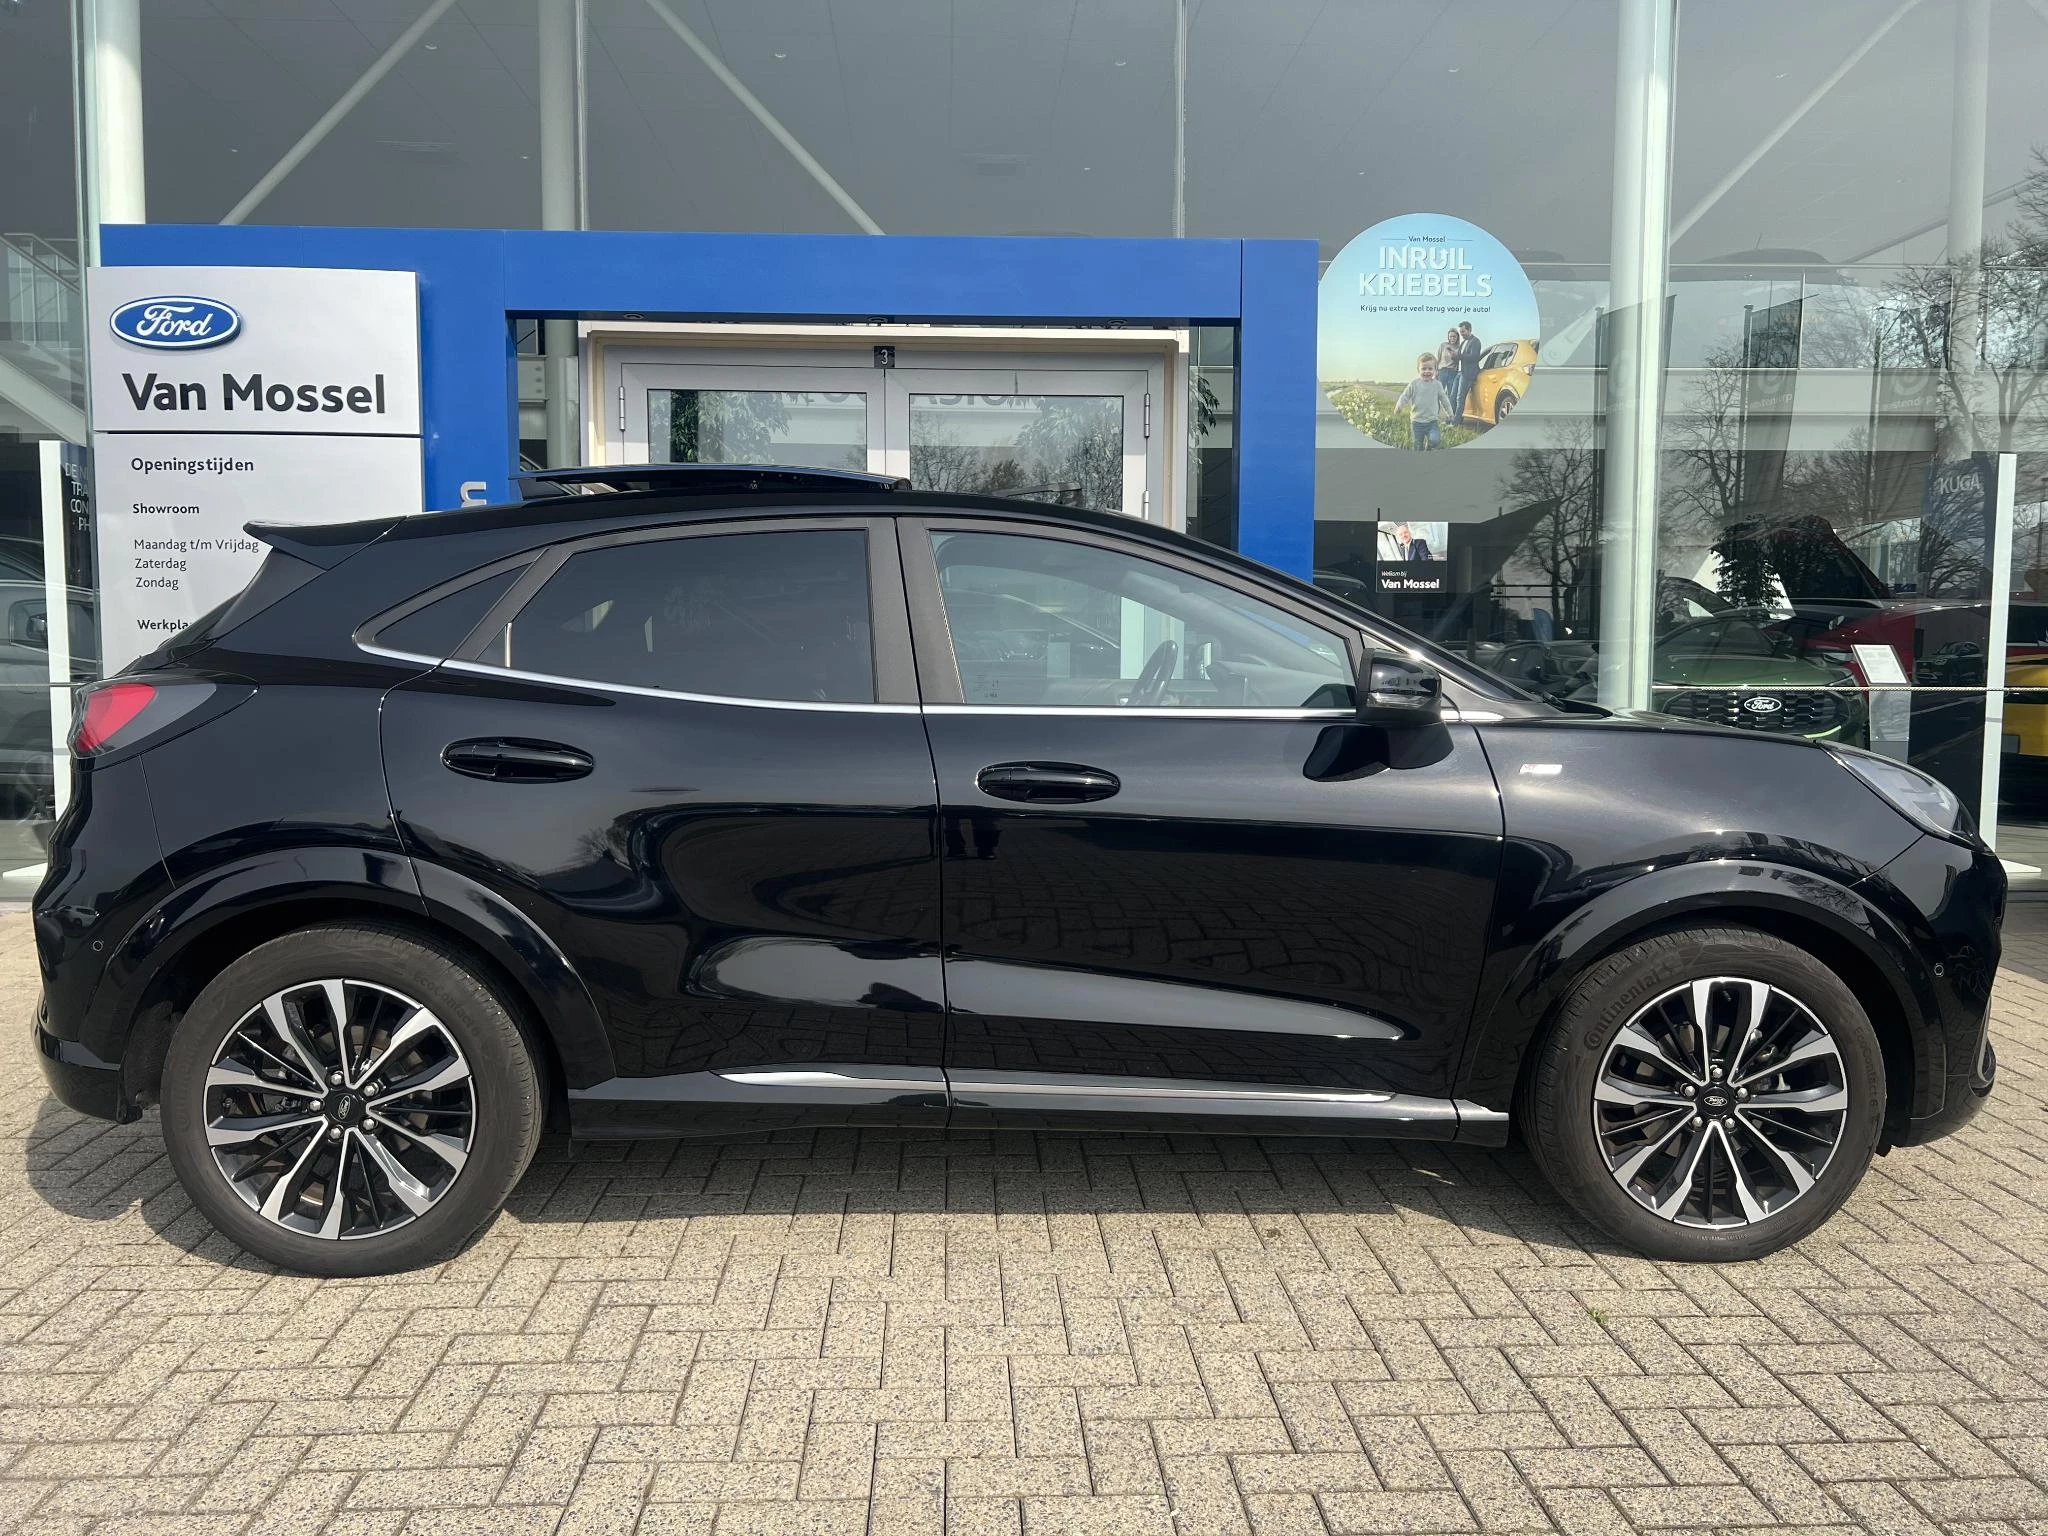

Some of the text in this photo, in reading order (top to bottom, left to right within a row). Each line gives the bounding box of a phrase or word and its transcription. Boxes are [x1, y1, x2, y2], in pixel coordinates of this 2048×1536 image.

[1380, 245, 1474, 270] INRUIL
[1360, 272, 1493, 297] KRIEBELS
[1360, 305, 1377, 313] Krijg
[1425, 305, 1445, 313] terug
[1463, 306, 1471, 314] je
[136, 304, 213, 336] Ford
[881, 349, 888, 365] 3
[122, 373, 386, 415] Van Mossel
[131, 457, 254, 475] Openingstijden
[1939, 471, 1980, 495] KUGA
[132, 502, 200, 514] Showroom
[134, 539, 260, 554] Maandag t/m Vrijdag
[135, 557, 187, 572] Zaterdag
[135, 576, 179, 591] Zondag
[1381, 579, 1440, 589] Van Mossel
[137, 619, 191, 633] Werkpla
[1751, 699, 1775, 710] Ford
[1583, 968, 1661, 1051] Continental
